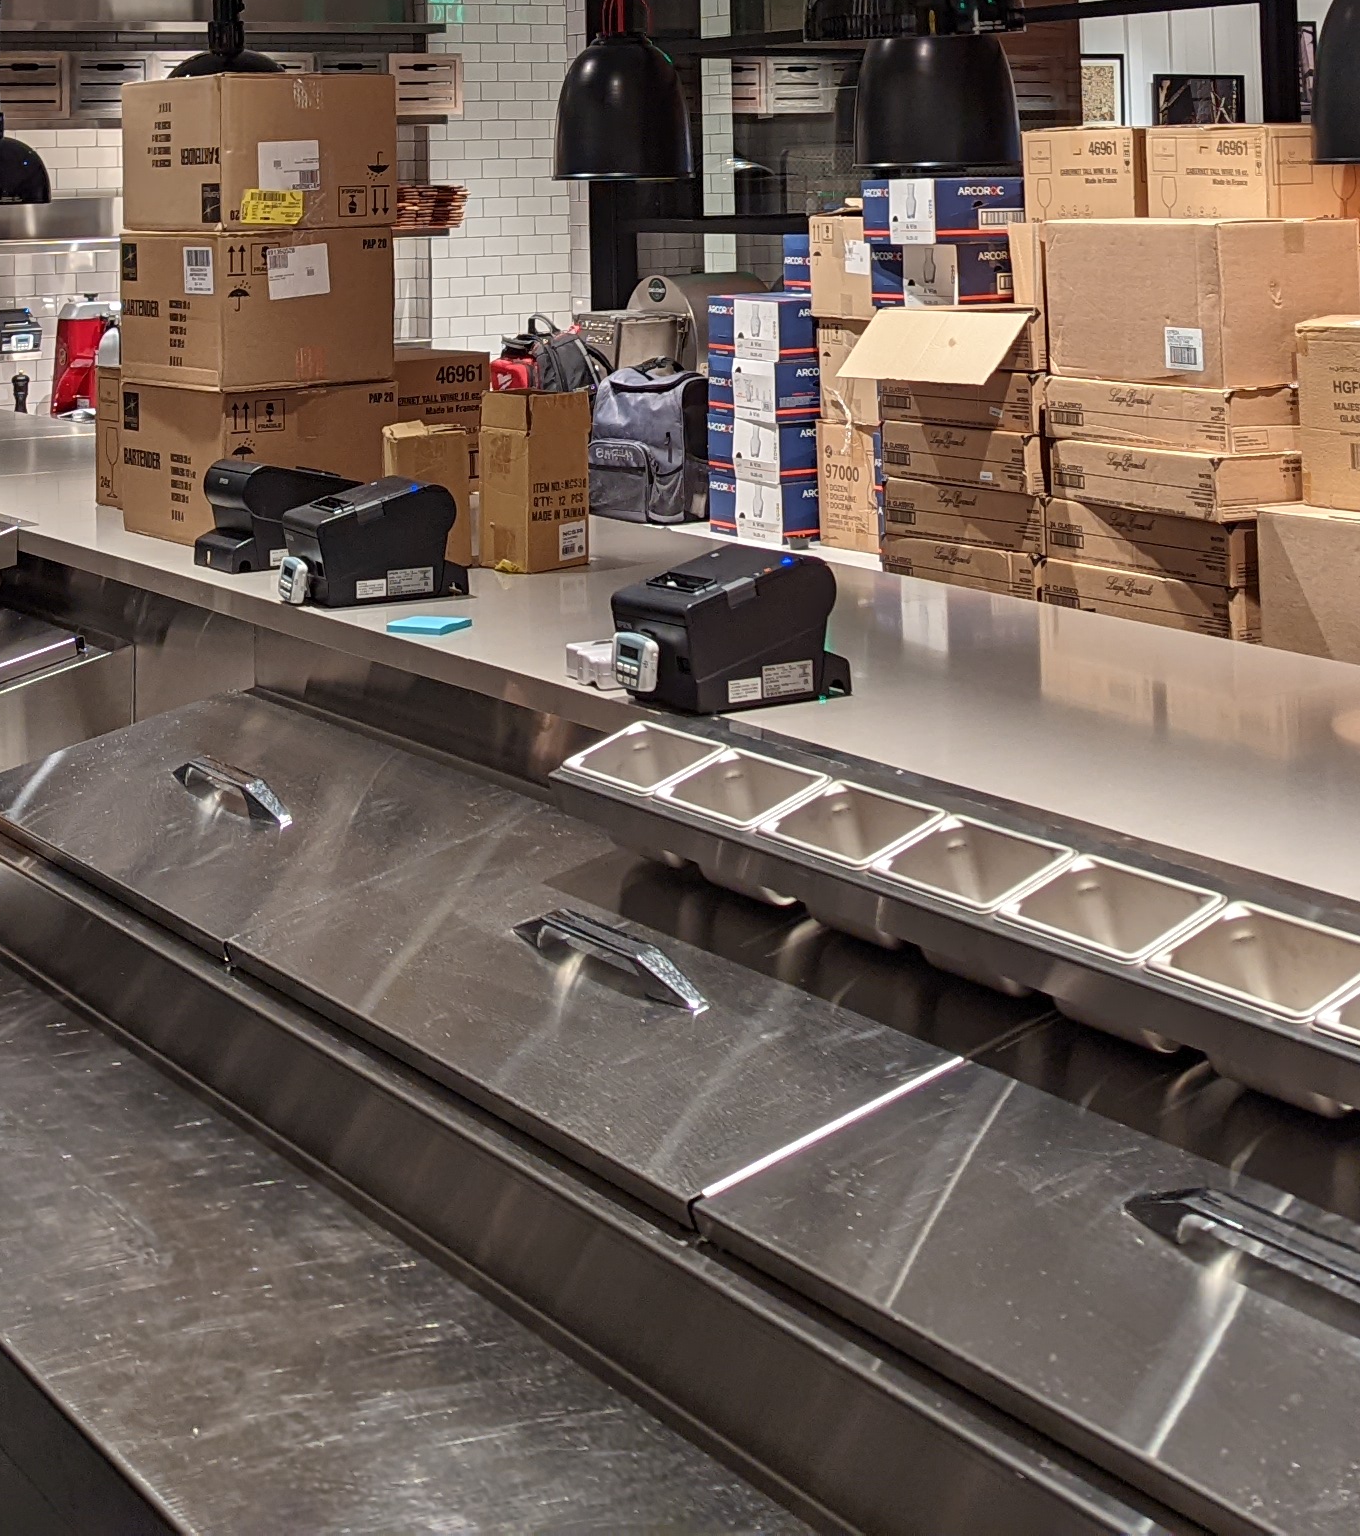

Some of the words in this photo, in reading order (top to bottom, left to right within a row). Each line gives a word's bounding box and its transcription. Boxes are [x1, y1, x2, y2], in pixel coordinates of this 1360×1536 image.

[1088, 141, 1117, 155] 46961
[1216, 141, 1248, 156] 46961
[863, 188, 889, 198] ARCOROC
[958, 186, 1004, 196] ARCOROC
[363, 239, 376, 250] PAP
[377, 238, 387, 249] 20
[871, 251, 902, 261] ARCOROC
[122, 299, 159, 317] BARTENDER
[708, 305, 734, 315] ARCOROC
[436, 364, 484, 385] 46961
[369, 392, 382, 404] PAP
[384, 392, 394, 403] 20
[426, 405, 444, 415] Made
[446, 405, 454, 414] in
[455, 404, 480, 413] France
[708, 421, 733, 434] ARCOROC
[124, 447, 161, 470] BARTENDER
[825, 464, 859, 482] 97000
[710, 480, 736, 493] ARCOROC
[559, 496, 566, 506] 12
[571, 493, 584, 504] PCS
[532, 510, 552, 522] MADE
[554, 509, 561, 520] IN
[562, 506, 586, 519] TAIWAN
